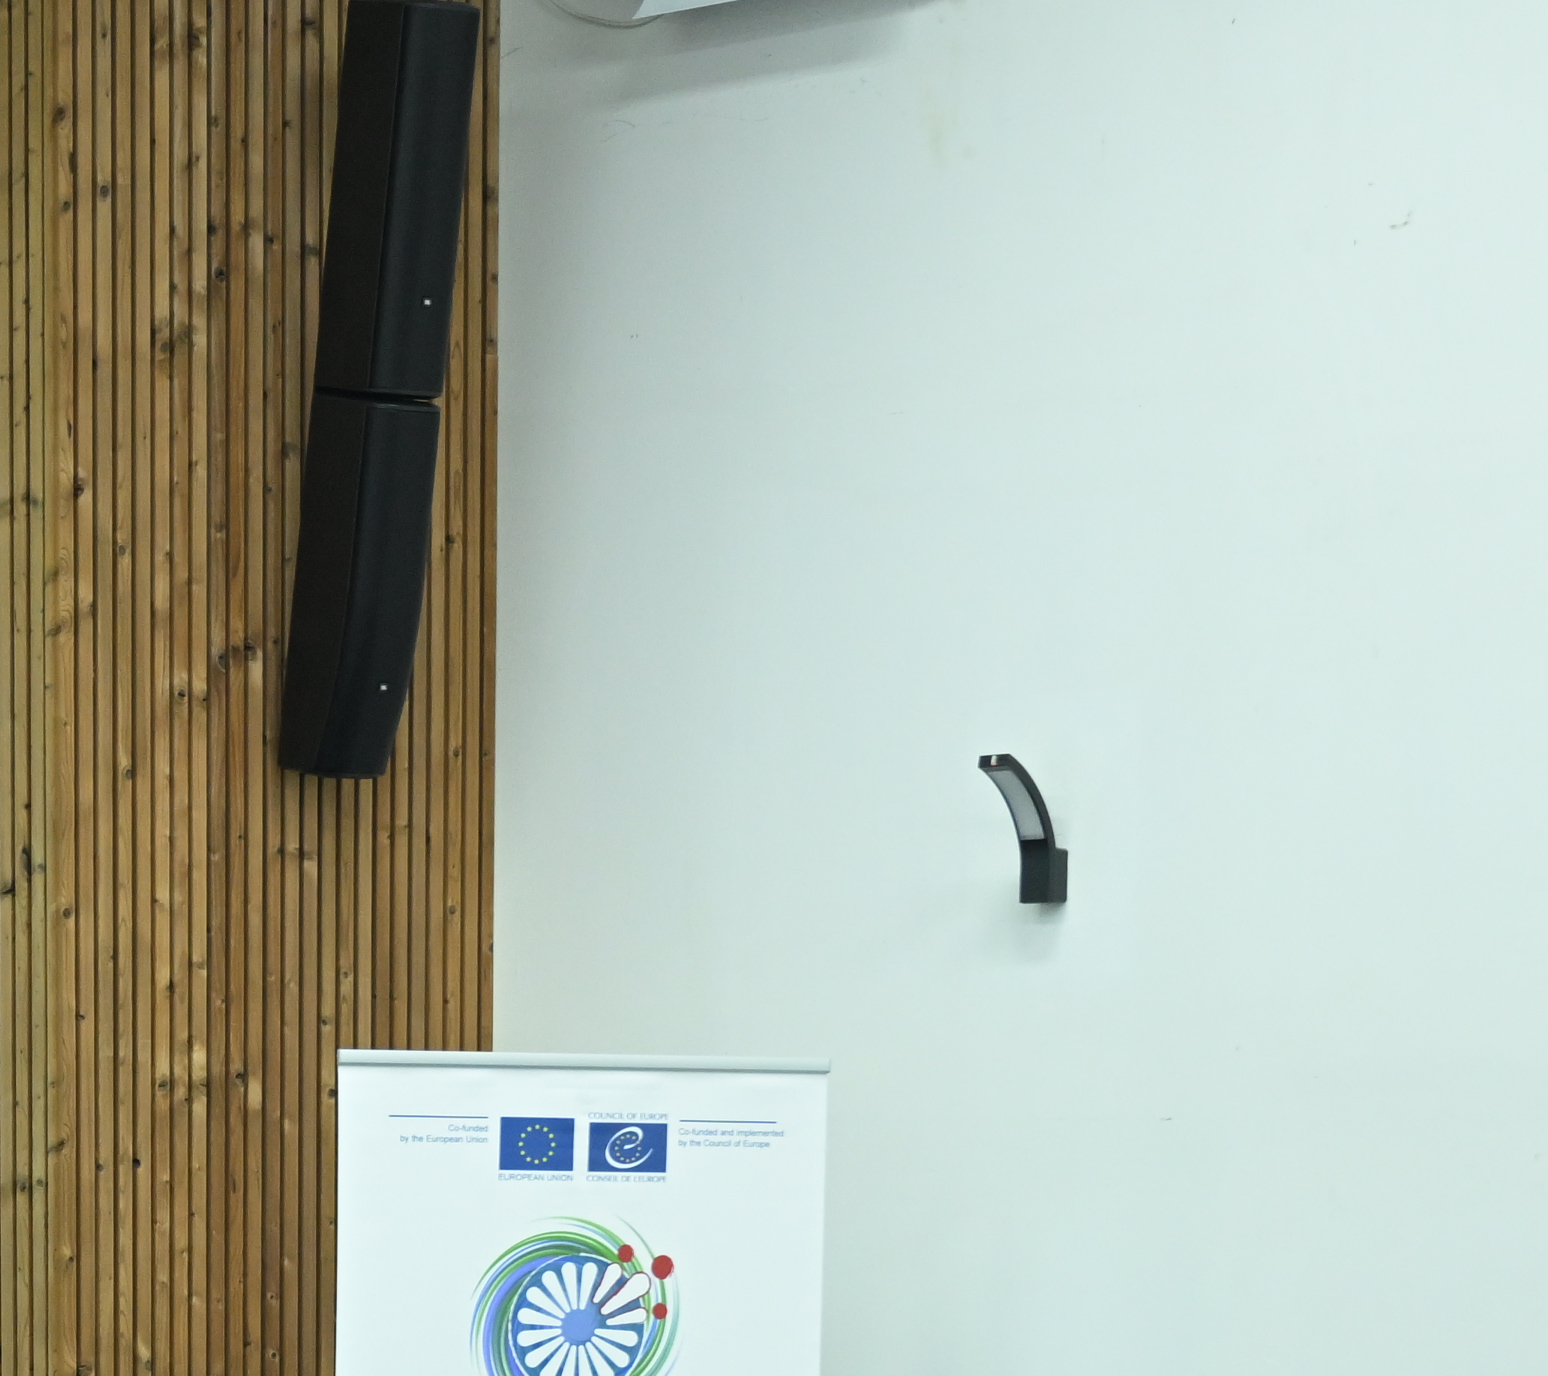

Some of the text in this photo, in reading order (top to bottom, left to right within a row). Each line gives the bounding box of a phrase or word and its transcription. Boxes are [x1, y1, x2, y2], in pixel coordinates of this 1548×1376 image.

[587, 1112, 669, 1121] COUNCIL OF EUROPE
[448, 1123, 489, 1133] Co-funded
[678, 1127, 784, 1139] Co-funded and implemented
[399, 1134, 488, 1144] by the European Union
[678, 1139, 770, 1149] by the Council of Europe
[498, 1173, 574, 1182] EUROPEAN UNION
[586, 1174, 619, 1183] CONSEIL
[621, 1175, 631, 1183] DE
